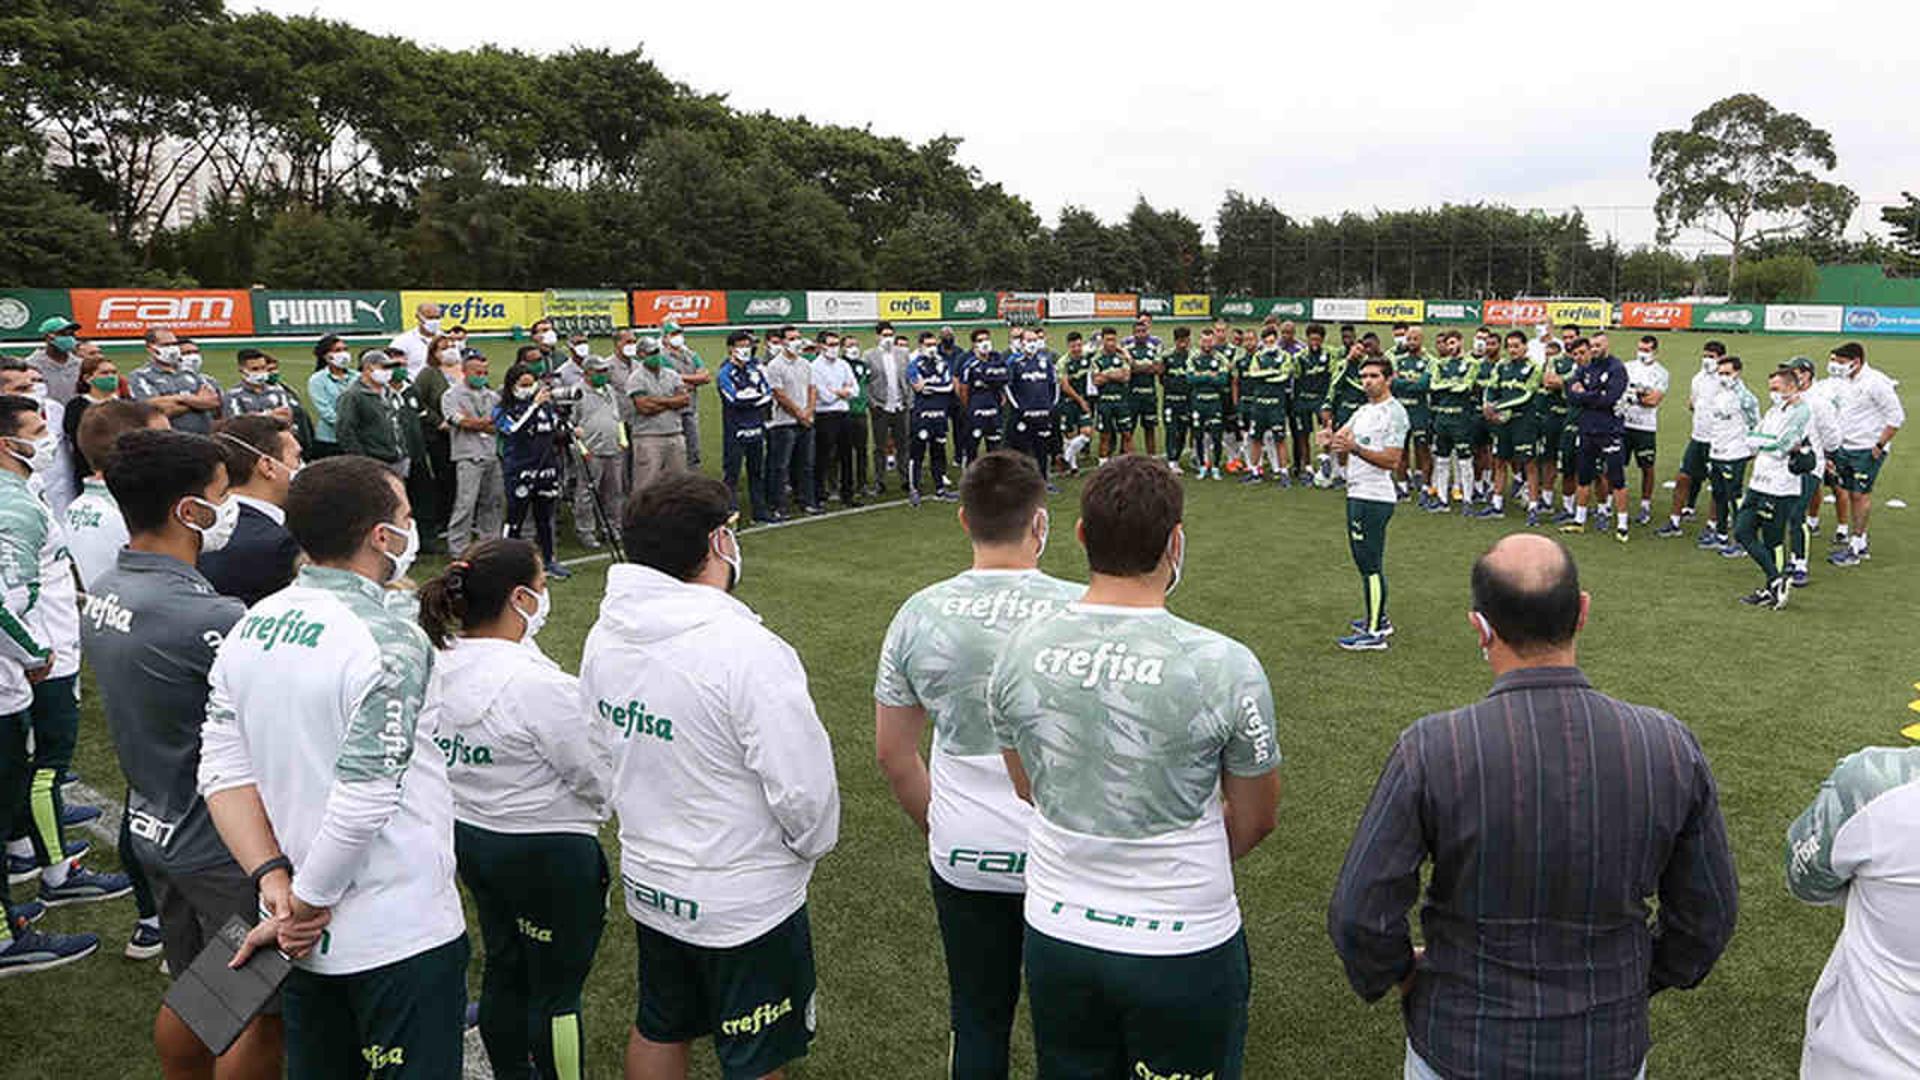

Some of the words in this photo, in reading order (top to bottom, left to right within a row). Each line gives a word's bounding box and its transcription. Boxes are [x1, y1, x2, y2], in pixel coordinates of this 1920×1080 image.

[269, 300, 352, 324] PUMA
[438, 297, 505, 324] refisa
[82, 593, 133, 632] refisa
[1034, 643, 1163, 688] crefisa
[722, 997, 793, 1036] crefisa
